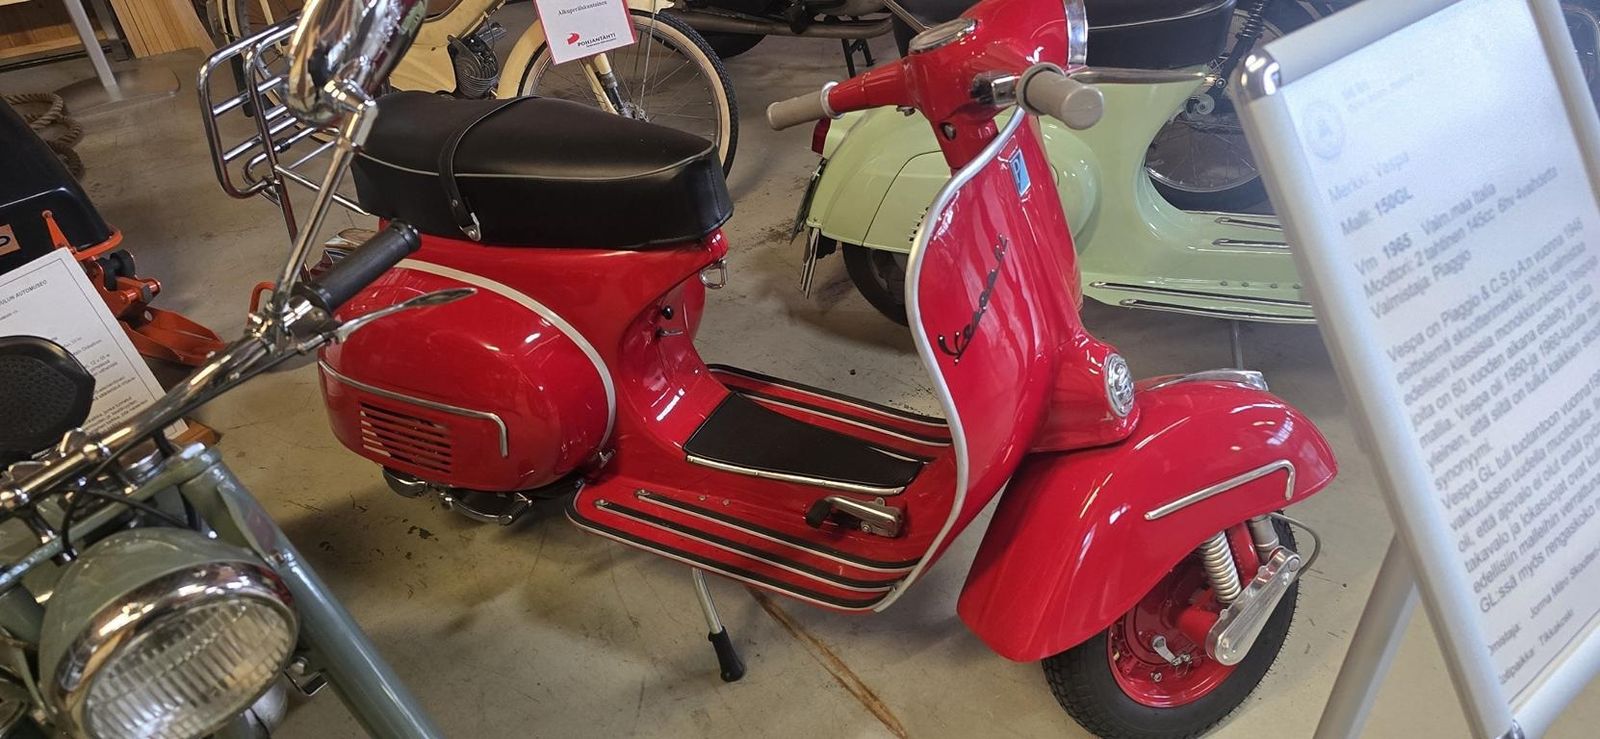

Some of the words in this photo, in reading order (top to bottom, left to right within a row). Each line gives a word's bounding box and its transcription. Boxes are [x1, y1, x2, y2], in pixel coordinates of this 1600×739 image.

[1374, 184, 1412, 216] 150GL
[1354, 253, 1377, 275] Vm
[1383, 232, 1411, 258] 1965
[1414, 251, 1423, 265] 2
[1433, 247, 1472, 283] Piaggio
[15, 279, 48, 298] AUTOMUSEO
[1386, 329, 1424, 366] Vespa
[1425, 321, 1440, 337] on
[1440, 291, 1481, 330] Piaggio
[1479, 285, 1488, 299] &
[1533, 234, 1564, 262] vuonna
[1402, 364, 1449, 406] edelleen
[1449, 333, 1493, 372] klassisia
[1410, 402, 1434, 430] joita
[1435, 391, 1450, 409] on
[1450, 377, 1467, 397] 60
[1466, 350, 1504, 385] vuoden
[1504, 327, 1535, 357] aikana
[1455, 387, 1490, 423] Vespa
[1489, 377, 1502, 395] oli
[1469, 414, 1489, 436] että
[1490, 397, 1510, 420] siitä
[1512, 388, 1524, 404] on
[1441, 474, 1478, 514] Vespa
[1477, 460, 1495, 483] GL
[1495, 448, 1511, 468] tuli
[1511, 408, 1559, 455] tuotantoon
[1559, 383, 1590, 415] vuonna
[1450, 475, 1511, 533] vaikutuksen
[1511, 446, 1545, 481] uudella
[1465, 527, 1509, 574] takavalo
[1509, 520, 1521, 539] ja
[1520, 477, 1567, 529] lokasuojat
[1567, 462, 1585, 484] ovat
[1475, 514, 1495, 538] että
[1497, 483, 1532, 522] ajovalo
[1531, 473, 1541, 489] ei
[1472, 548, 1517, 595] edellisiin
[1517, 510, 1559, 554] malleihin
[1479, 572, 1516, 614] GL:ssä
[1517, 550, 1545, 583] myös
[1544, 503, 1595, 559] rengaskoko
